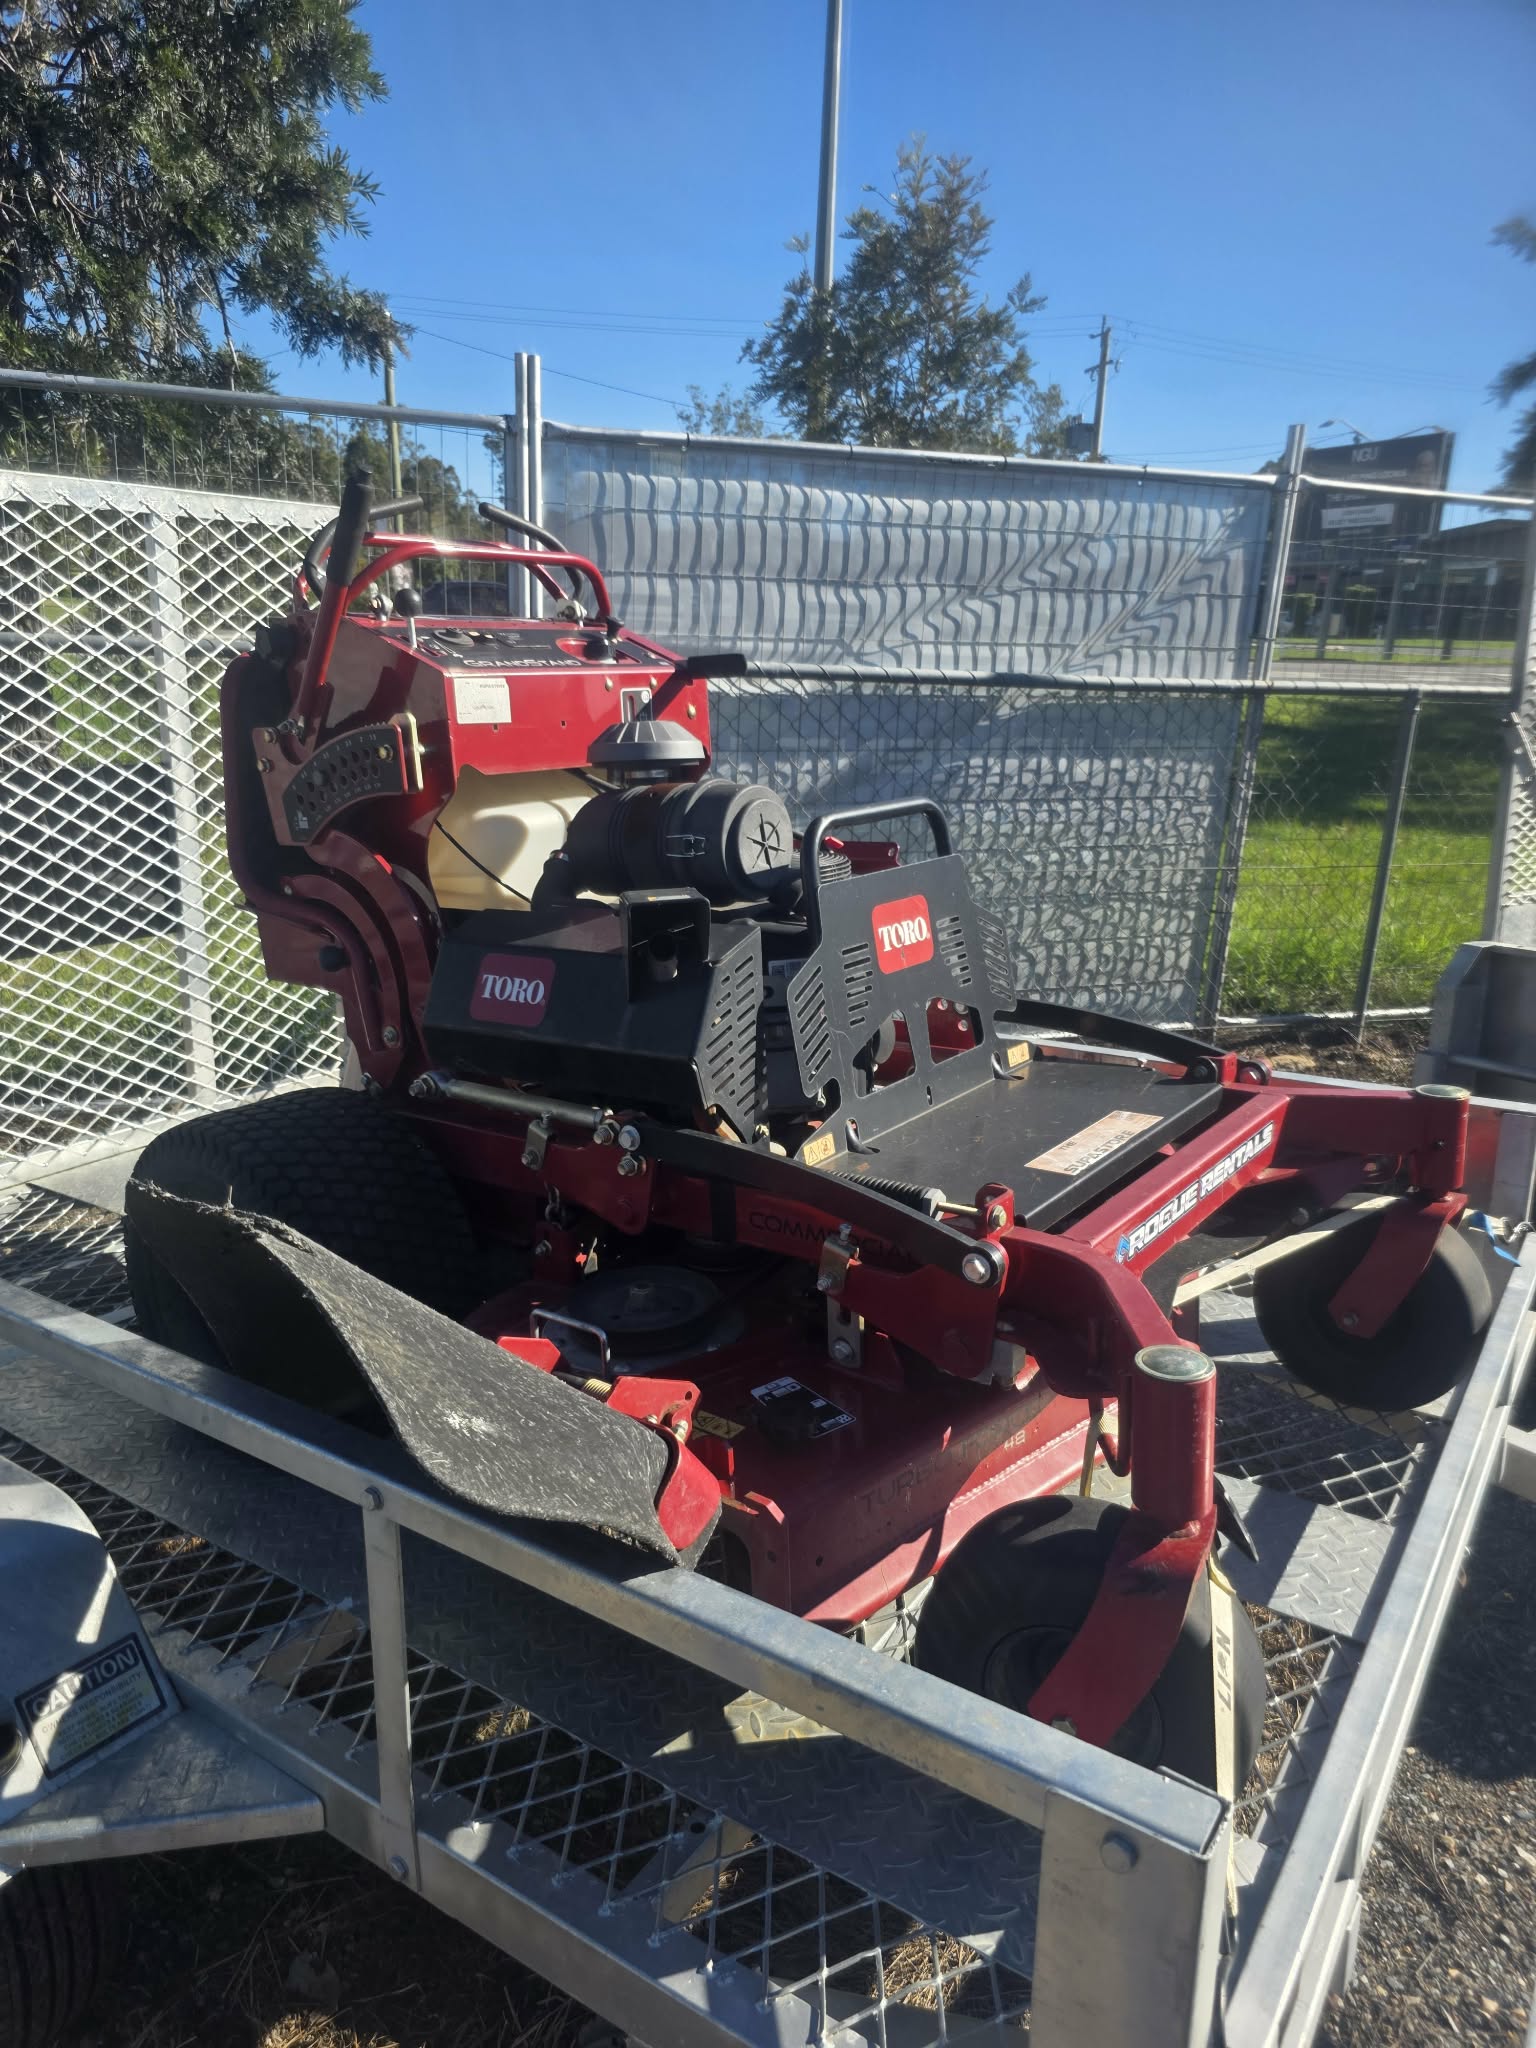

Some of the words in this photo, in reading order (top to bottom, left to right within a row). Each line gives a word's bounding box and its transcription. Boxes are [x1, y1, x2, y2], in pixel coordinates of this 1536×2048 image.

[878, 916, 928, 952] TORO
[481, 974, 545, 1005] TORO
[1060, 1140, 1077, 1152] THE
[1063, 1129, 1134, 1174] SUPASTORE
[1128, 1180, 1199, 1258] ROGUE
[1200, 1122, 1274, 1198] RENTALS
[750, 1212, 916, 1261] COMMCIAL
[1003, 1429, 1026, 1450] 48
[32, 1647, 136, 1717] CAUTION
